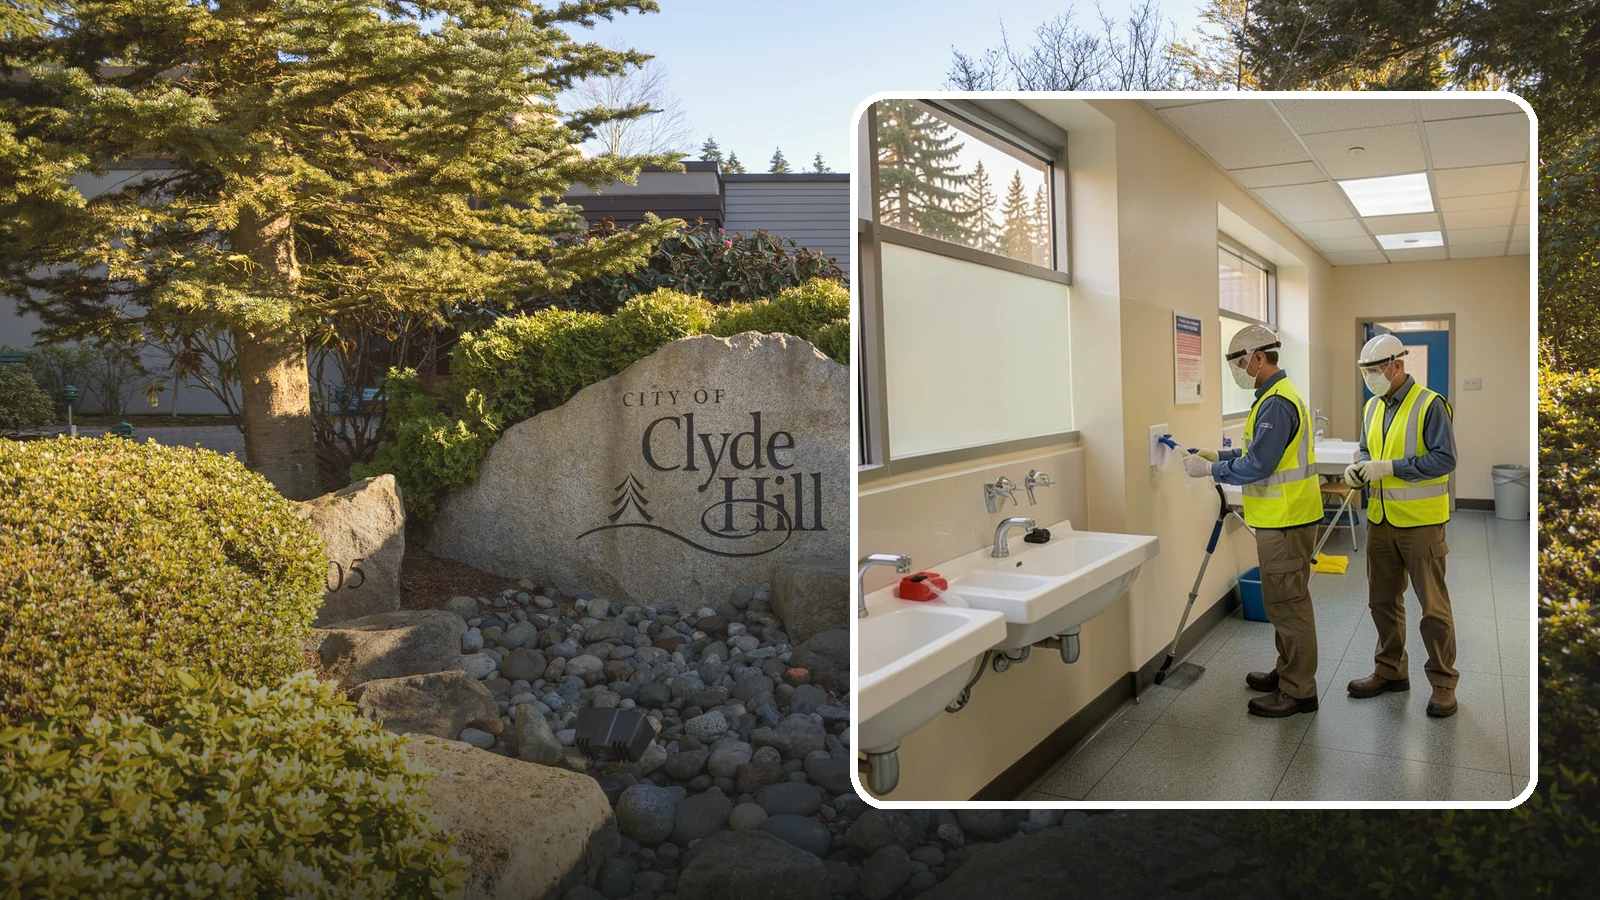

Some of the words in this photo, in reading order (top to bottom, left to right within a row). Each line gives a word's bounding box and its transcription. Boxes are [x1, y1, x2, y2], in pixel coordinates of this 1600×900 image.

[622, 391, 680, 407] CITY
[693, 389, 726, 404] OF
[641, 411, 795, 493] Clyde
[718, 472, 828, 532] Hill
